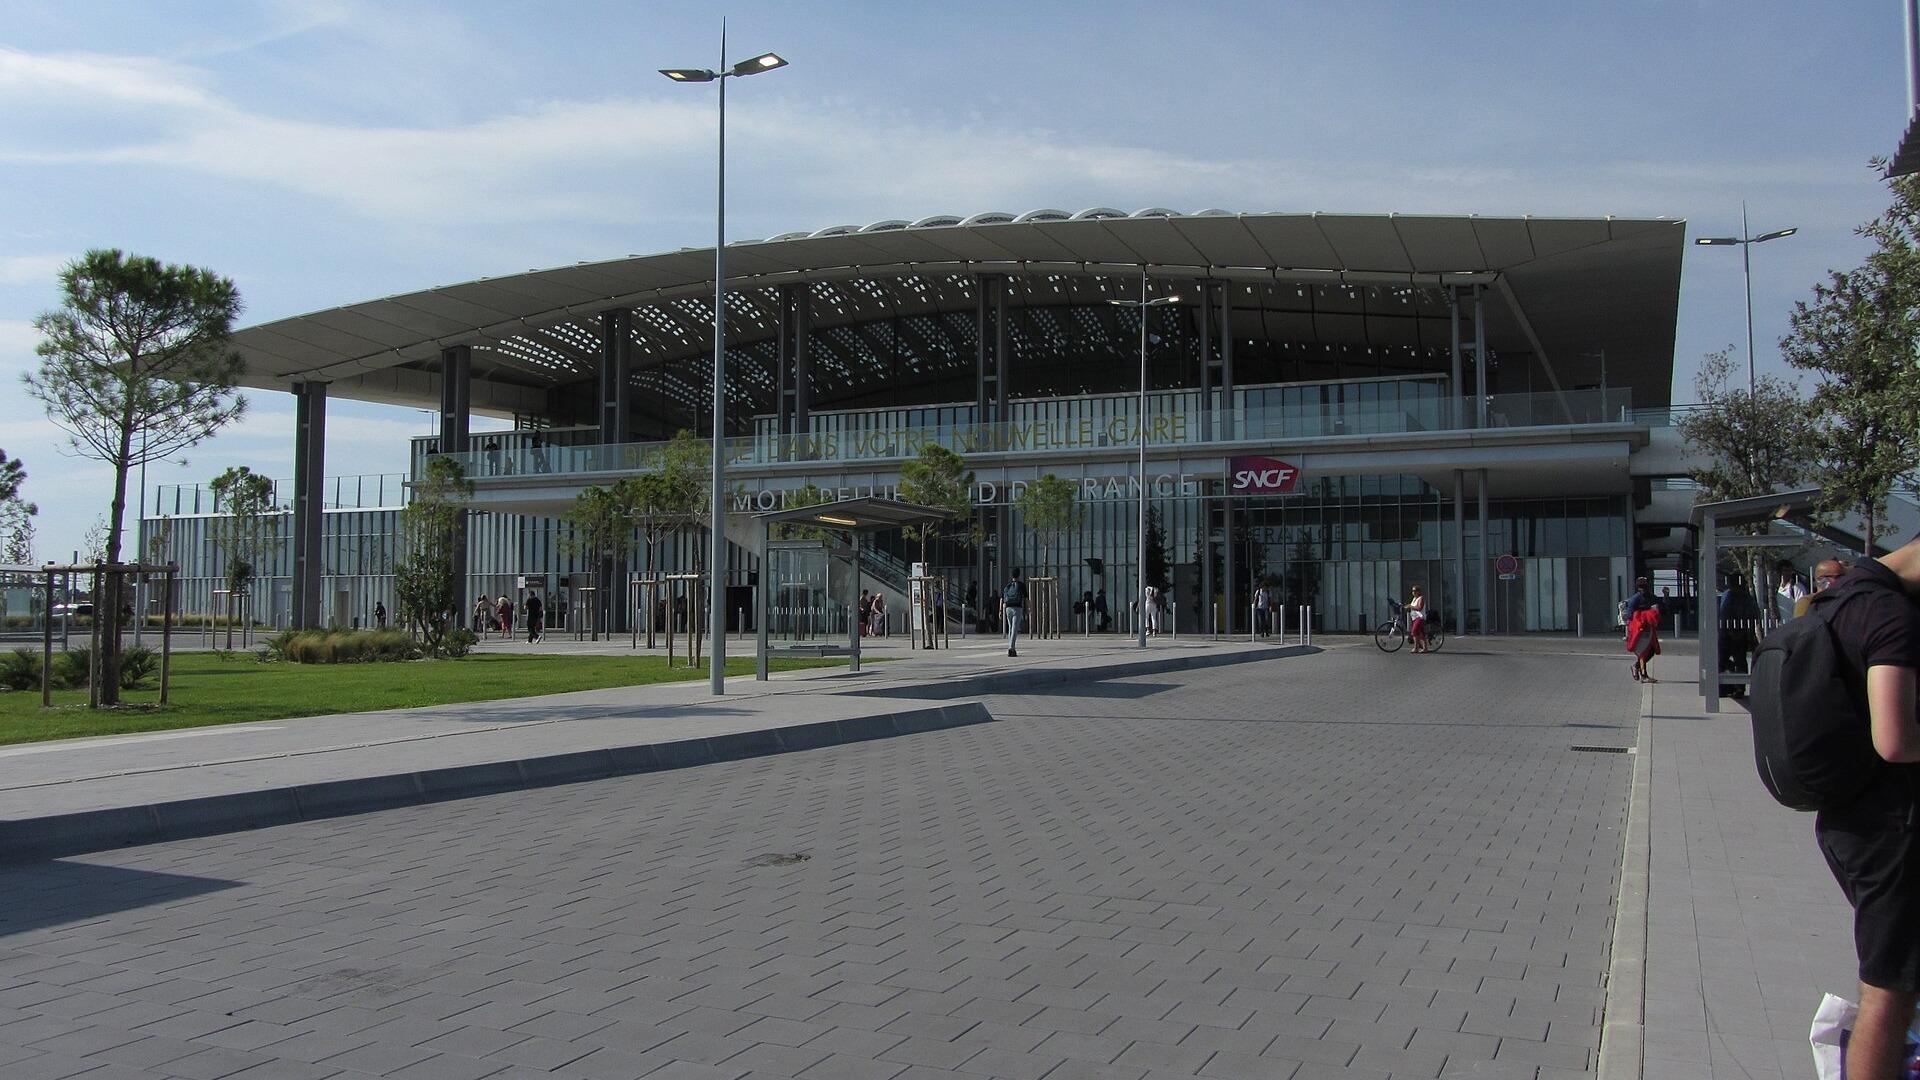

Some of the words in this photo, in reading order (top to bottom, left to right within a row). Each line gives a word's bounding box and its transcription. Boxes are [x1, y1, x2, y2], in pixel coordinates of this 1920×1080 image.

[624, 439, 752, 467] BIEUE
[767, 433, 838, 461] DANS
[853, 429, 936, 456] VOTRE
[951, 419, 1094, 452] NOUVELLE
[1108, 415, 1187, 442] GARE
[1233, 468, 1294, 489] SNCF
[733, 485, 909, 511] MONPELLIE
